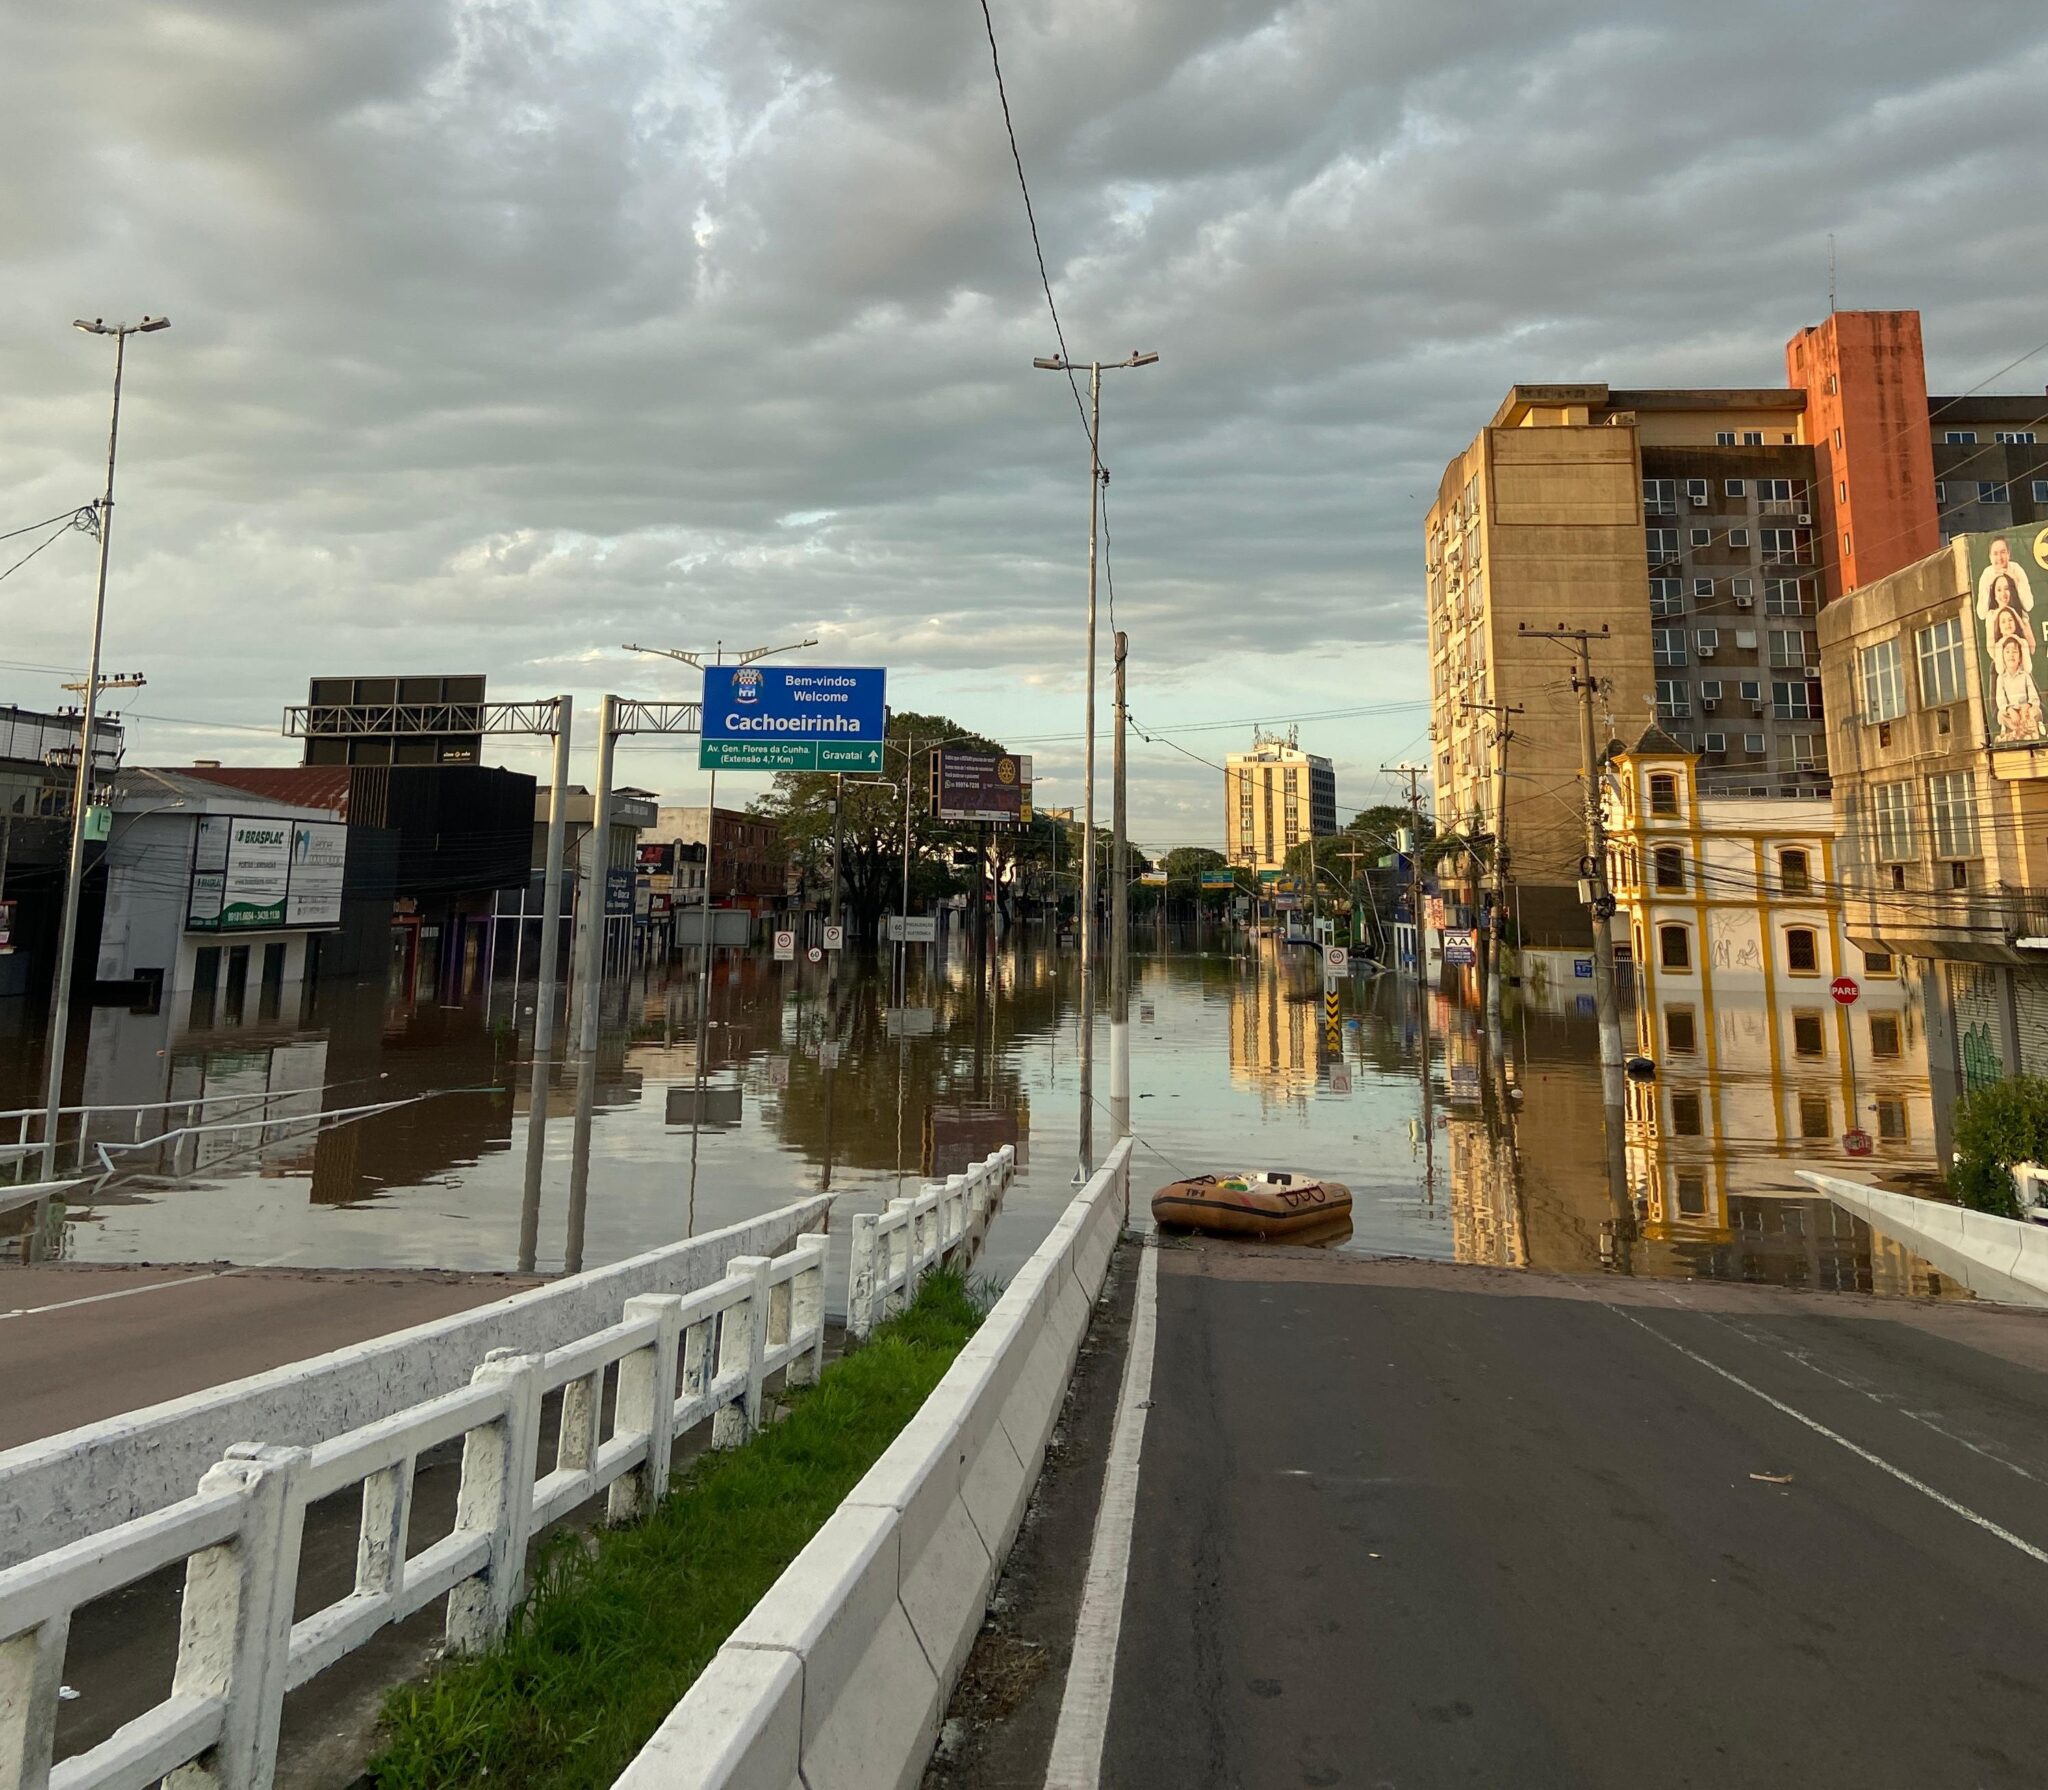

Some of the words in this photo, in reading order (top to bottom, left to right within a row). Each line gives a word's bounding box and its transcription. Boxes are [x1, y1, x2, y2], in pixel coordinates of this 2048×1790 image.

[785, 675, 857, 687] Bem-vindos
[794, 691, 848, 702] Welcome
[725, 714, 861, 732] Cachoeirinha
[743, 745, 768, 753] Flores
[721, 755, 761, 764] (Extensão
[763, 755, 775, 764] 4,7
[777, 756, 794, 765] Km)
[244, 830, 284, 844] BRASPLAC
[1447, 938, 1470, 946] AA
[810, 950, 820, 958] 60
[1832, 987, 1858, 996] PARE
